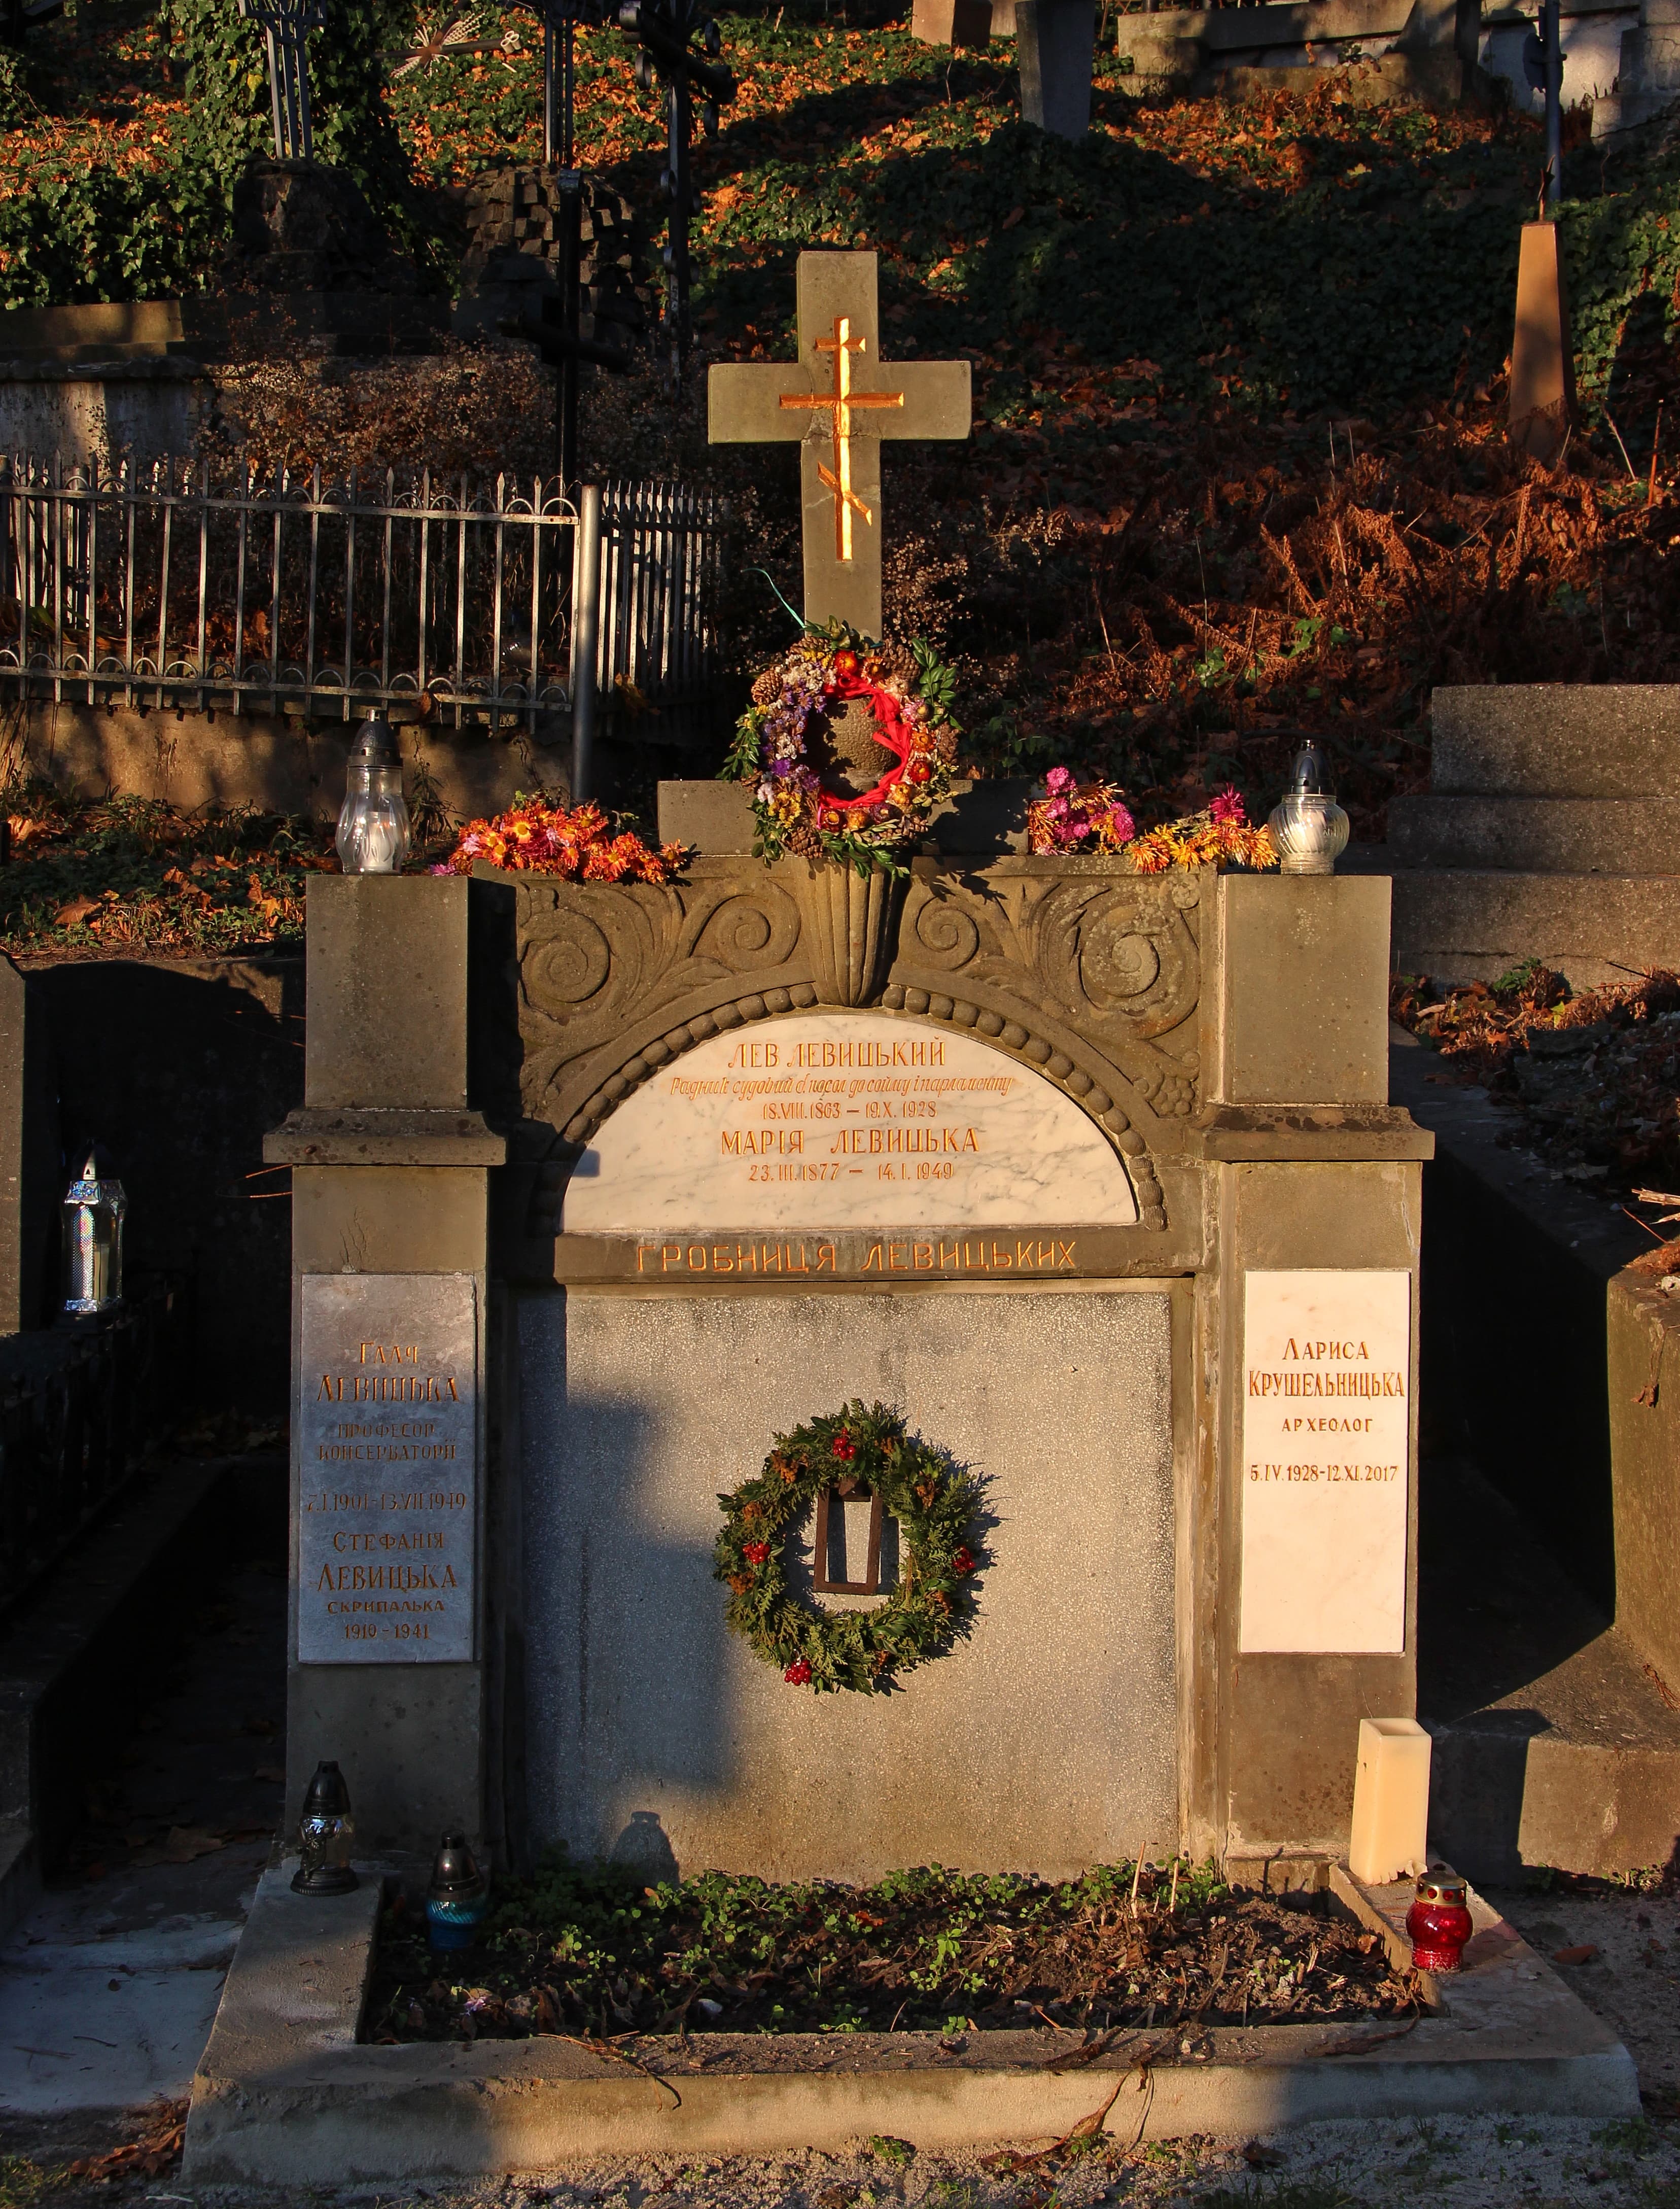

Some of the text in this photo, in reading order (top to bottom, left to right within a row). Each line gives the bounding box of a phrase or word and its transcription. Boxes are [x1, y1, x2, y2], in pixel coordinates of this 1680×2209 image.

[728, 1036, 946, 1068] ЛЕВ ЛЕВИЦЬКИЙ
[671, 1077, 730, 1100] Радник
[732, 1077, 794, 1100] судовий
[721, 1128, 980, 1155] МАРІЯ ЛЕВИЦЬКА
[638, 1241, 1076, 1273] ГРОБНИЦЯ ЛЕВИЦЬКИХ
[317, 1375, 460, 1403] ЛЕВИЦЬКА
[338, 1423, 435, 1438] ПРОФЕСОР
[1282, 1418, 1373, 1433] АРХЕОЛОГ
[319, 1438, 457, 1462] КОНСЕРВАТОРІЇ
[317, 1563, 458, 1594] ЛЕВИЦЬКА
[327, 1600, 445, 1615] СКРИПАЛЬКА
[344, 1624, 377, 1640] 1910
[394, 1623, 430, 1640] 1941
